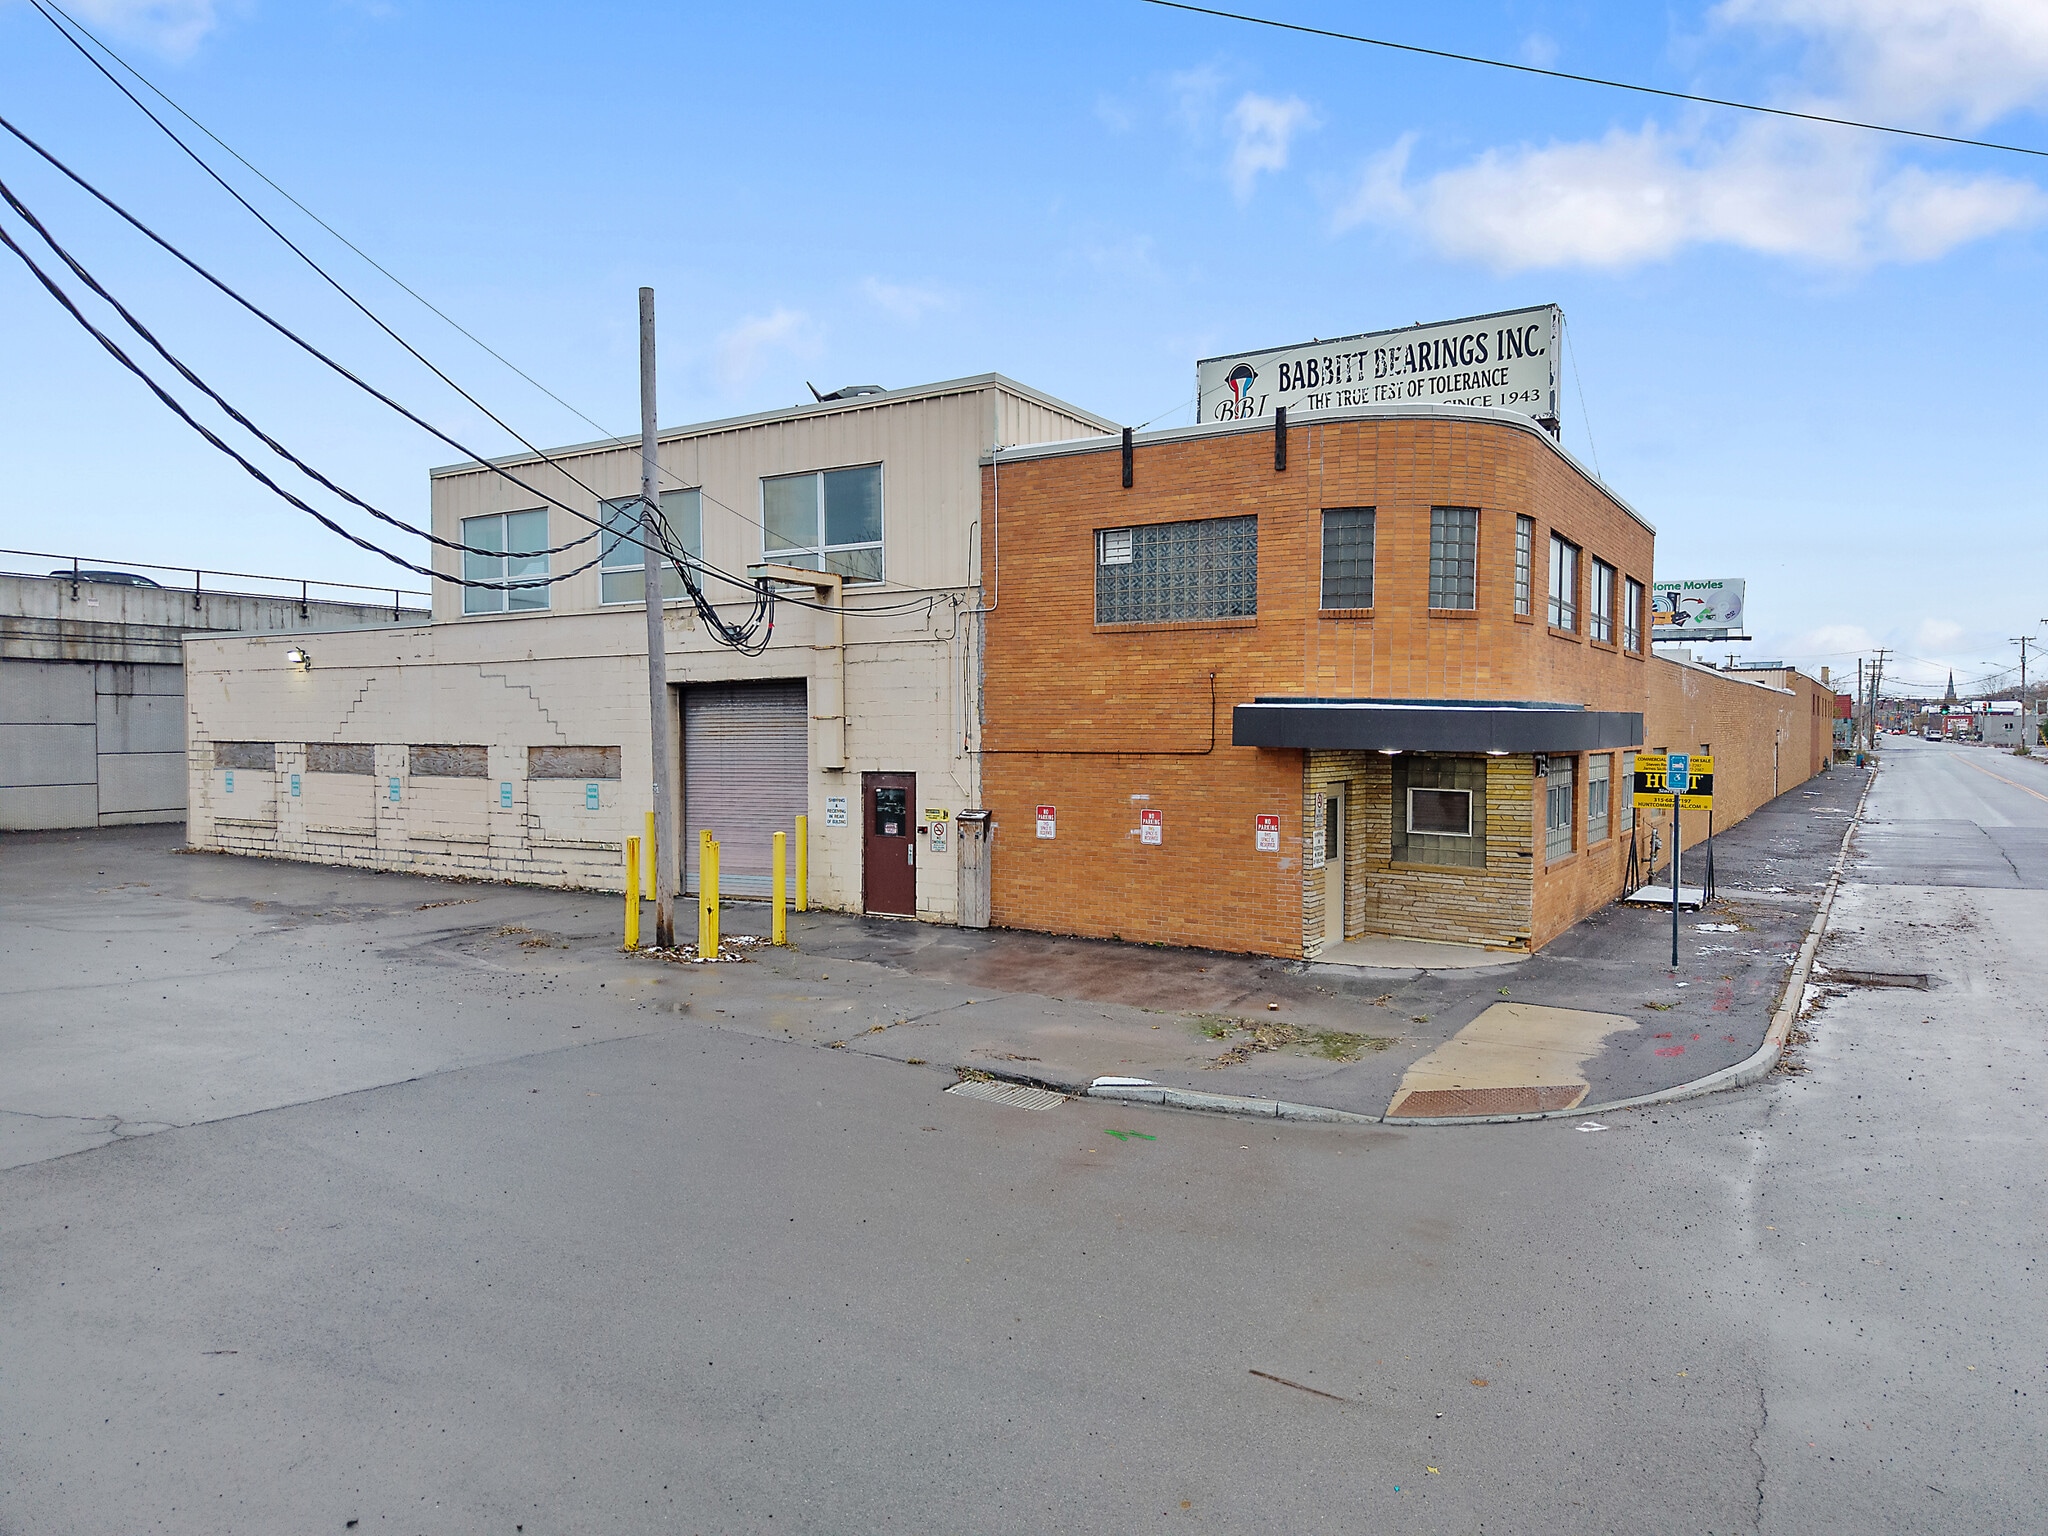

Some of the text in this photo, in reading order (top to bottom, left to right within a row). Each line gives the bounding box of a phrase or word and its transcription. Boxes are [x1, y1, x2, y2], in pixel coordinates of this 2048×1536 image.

[1278, 324, 1546, 392] BABBITT BEARINGS INC.
[1336, 387, 1369, 406] TRUE
[1407, 378, 1425, 397] OF
[1428, 367, 1509, 395] TOLERANCE
[1501, 389, 1540, 405] 1943
[1684, 581, 1723, 590] Movies
[1645, 773, 1701, 790] HUT
